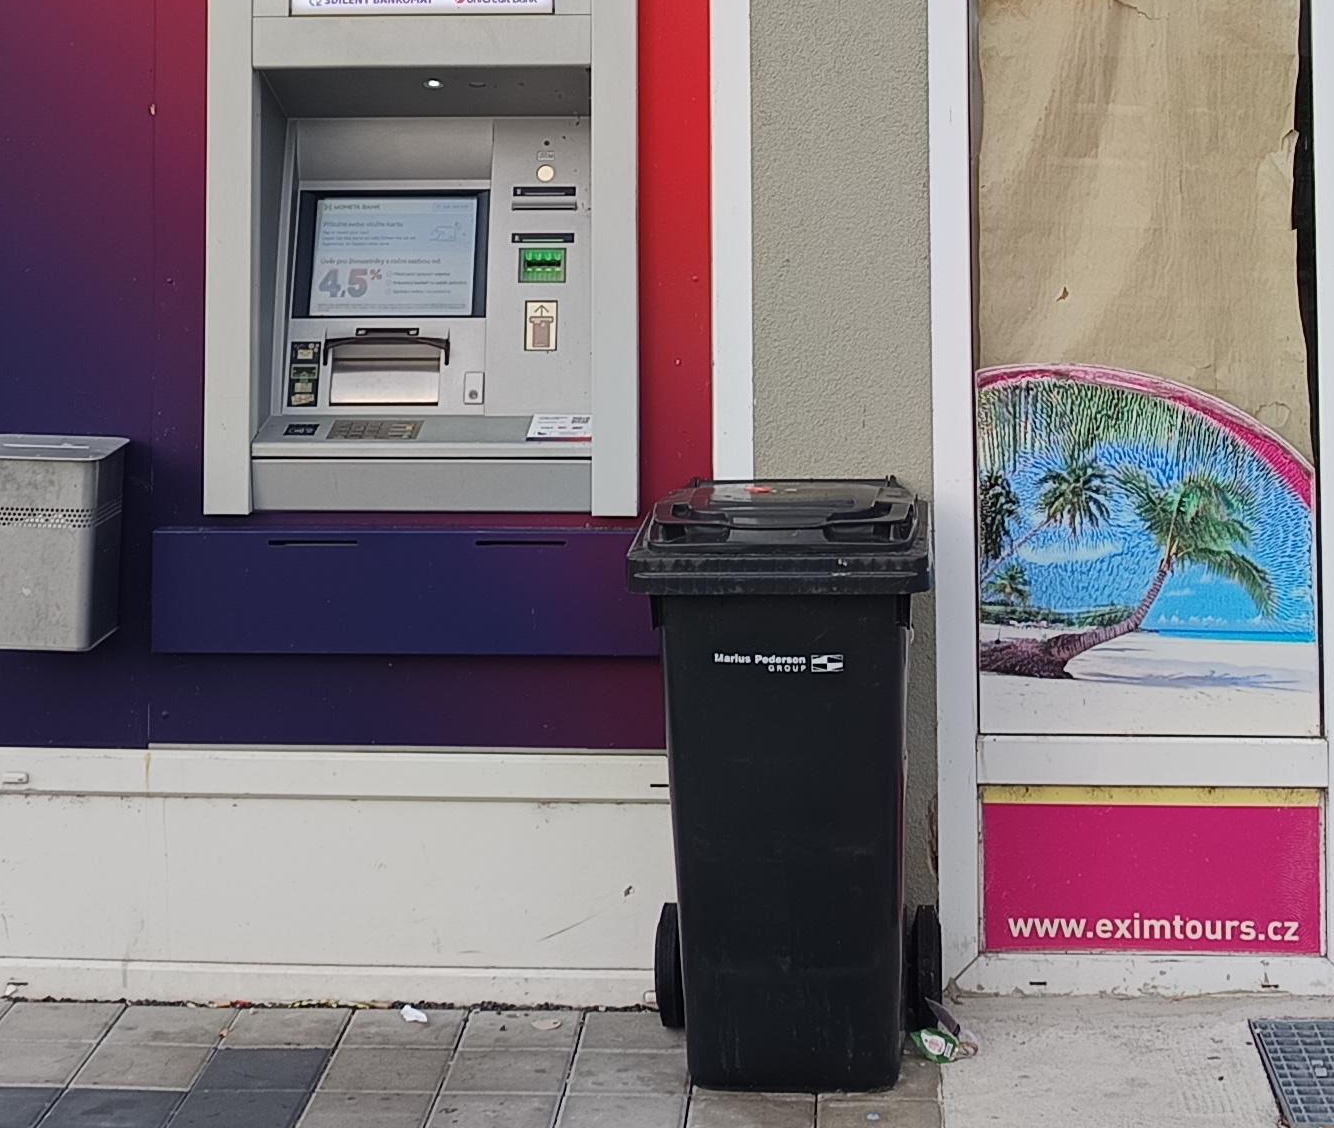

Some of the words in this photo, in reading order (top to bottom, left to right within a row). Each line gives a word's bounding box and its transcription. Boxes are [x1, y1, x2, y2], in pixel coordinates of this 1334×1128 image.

[714, 653, 751, 664] Marius
[754, 654, 806, 664] Pedersen
[768, 664, 807, 672] GROUP
[1008, 912, 1300, 942] www.eximtours.cz
